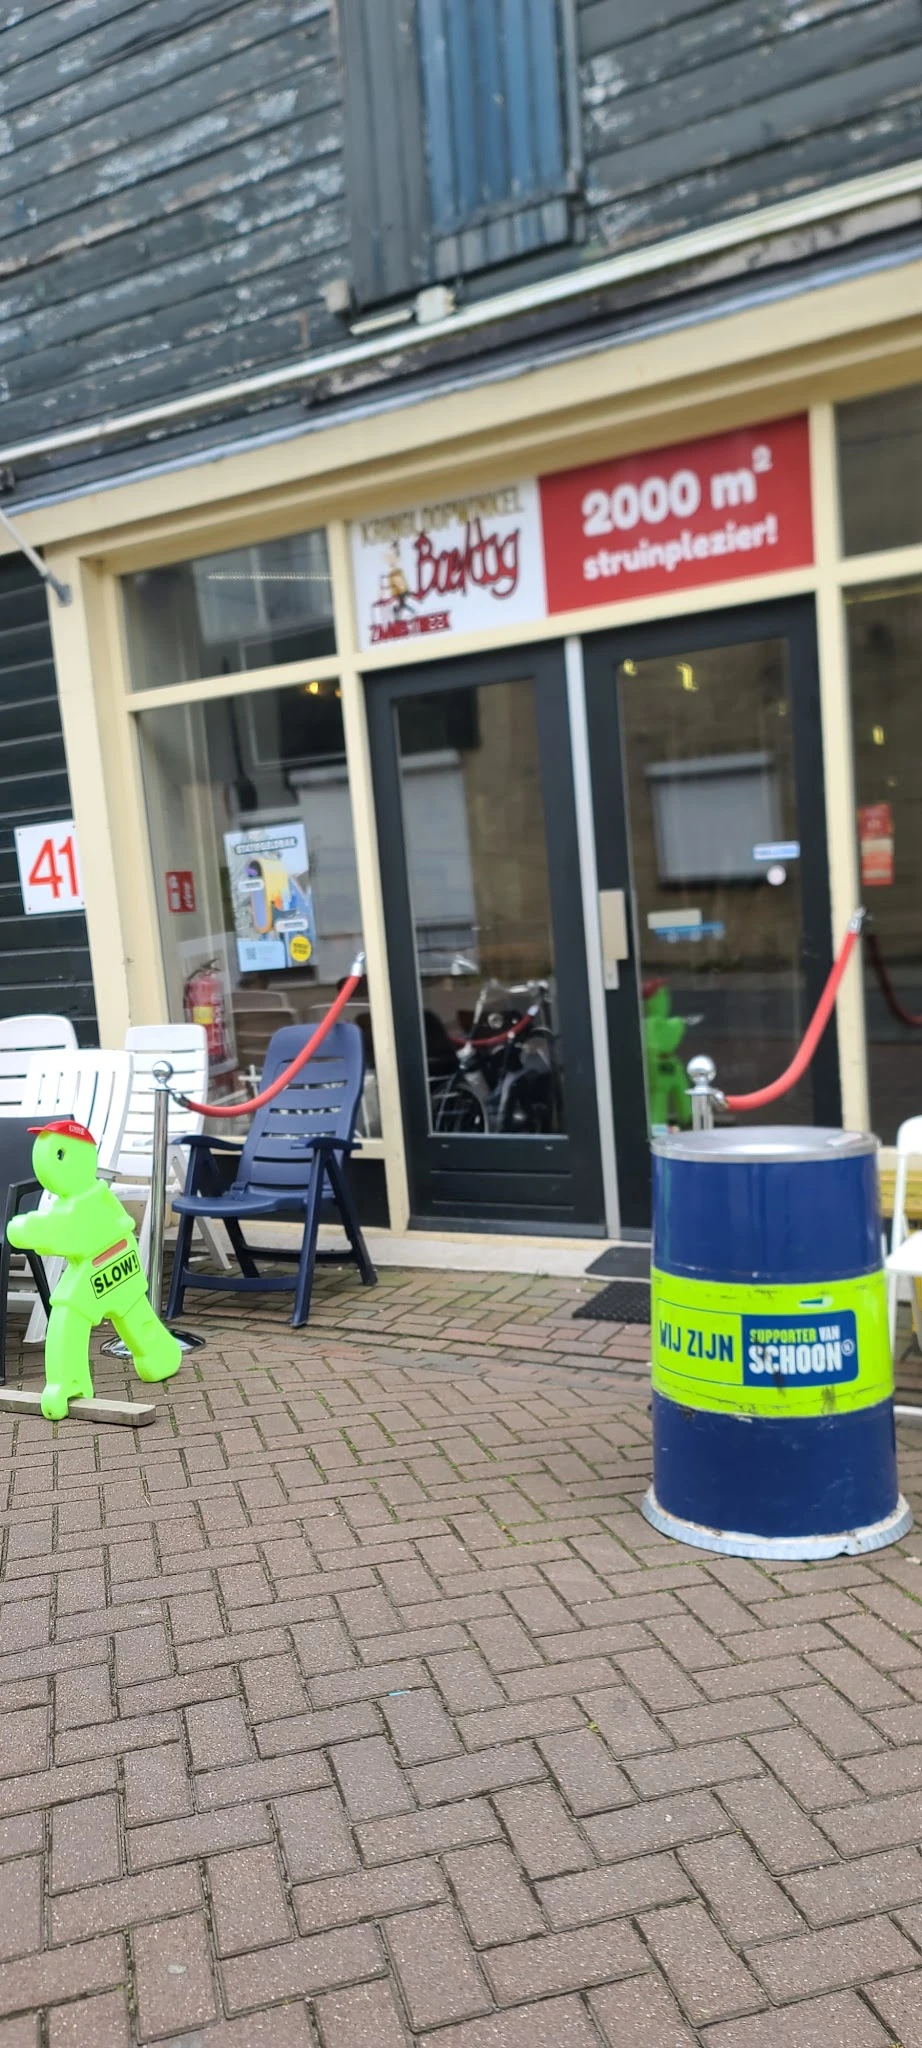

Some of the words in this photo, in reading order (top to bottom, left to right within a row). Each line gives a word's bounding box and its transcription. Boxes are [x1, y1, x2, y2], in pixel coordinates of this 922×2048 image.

[582, 469, 700, 537] 2000
[583, 515, 778, 580] struinplezier!
[28, 836, 79, 899] 41
[94, 1255, 139, 1293] SLOW!
[659, 1320, 681, 1352] WIJ
[687, 1329, 734, 1363] ZIJN
[749, 1328, 817, 1344] SUPPORTER
[818, 1325, 840, 1341] VAN
